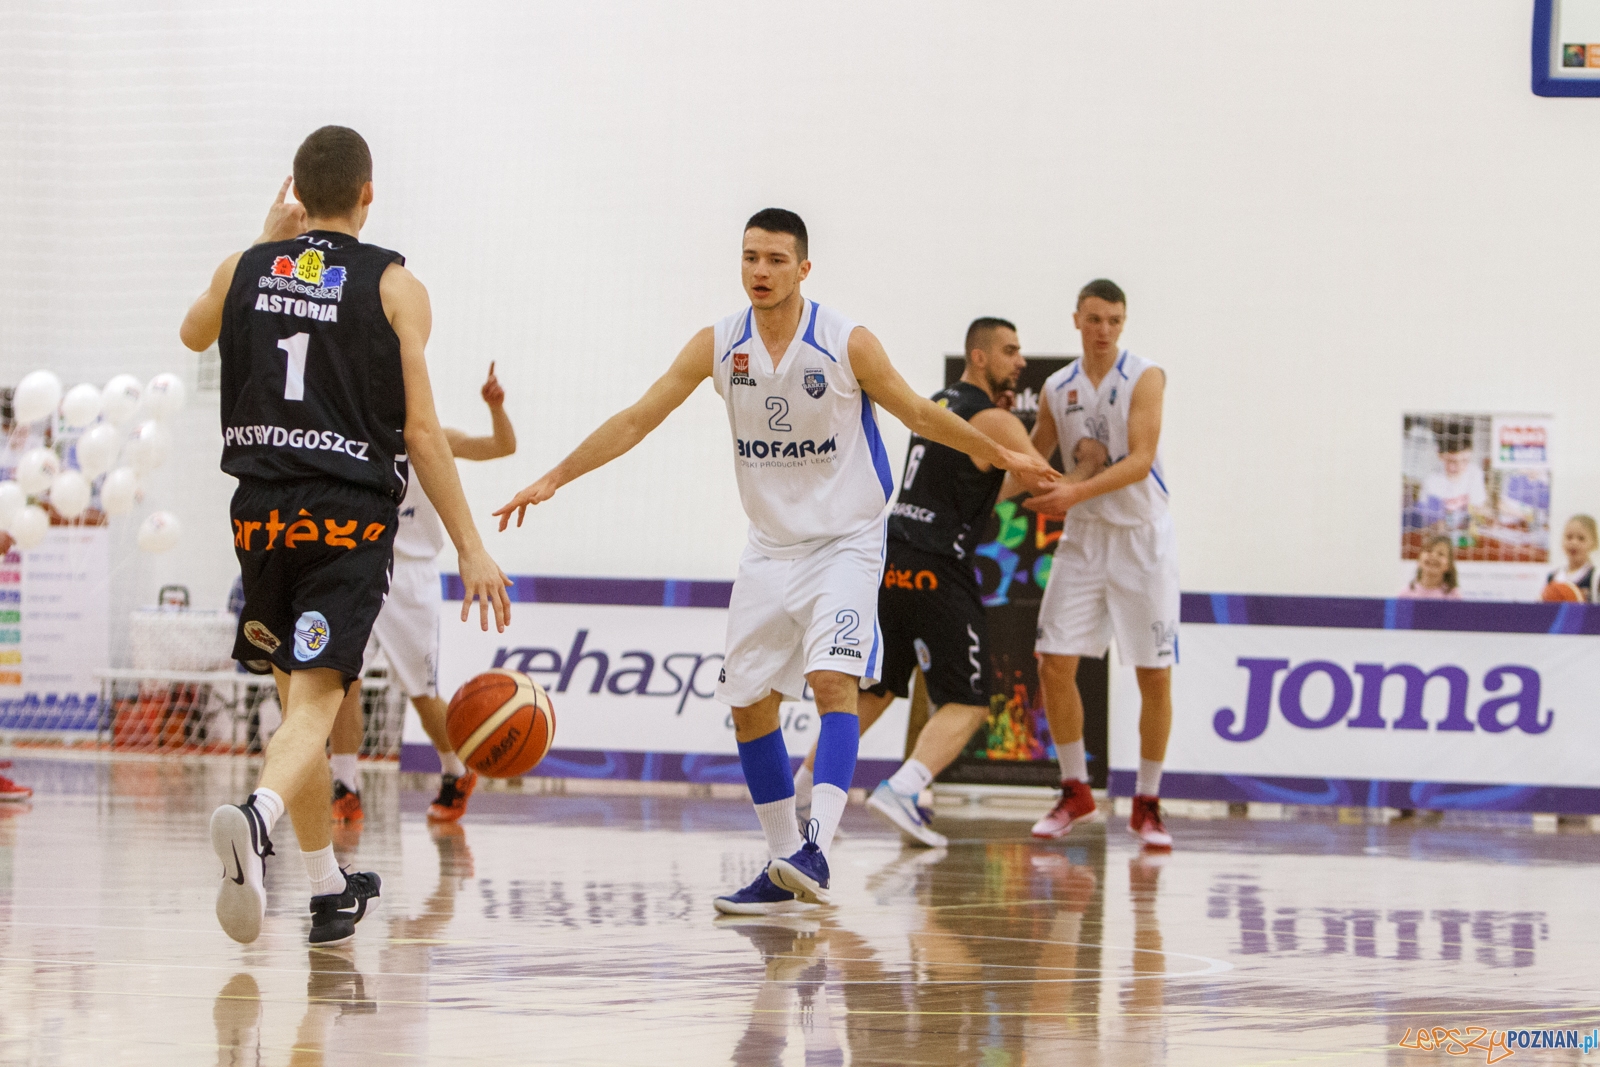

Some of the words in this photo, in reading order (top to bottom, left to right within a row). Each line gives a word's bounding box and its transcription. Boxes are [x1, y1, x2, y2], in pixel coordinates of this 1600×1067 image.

[255, 294, 338, 322] ASTORIA
[277, 332, 310, 401] 1
[765, 396, 792, 432] 2
[737, 435, 836, 459] BIOFARM
[903, 444, 926, 490] 6
[835, 609, 860, 645] 2
